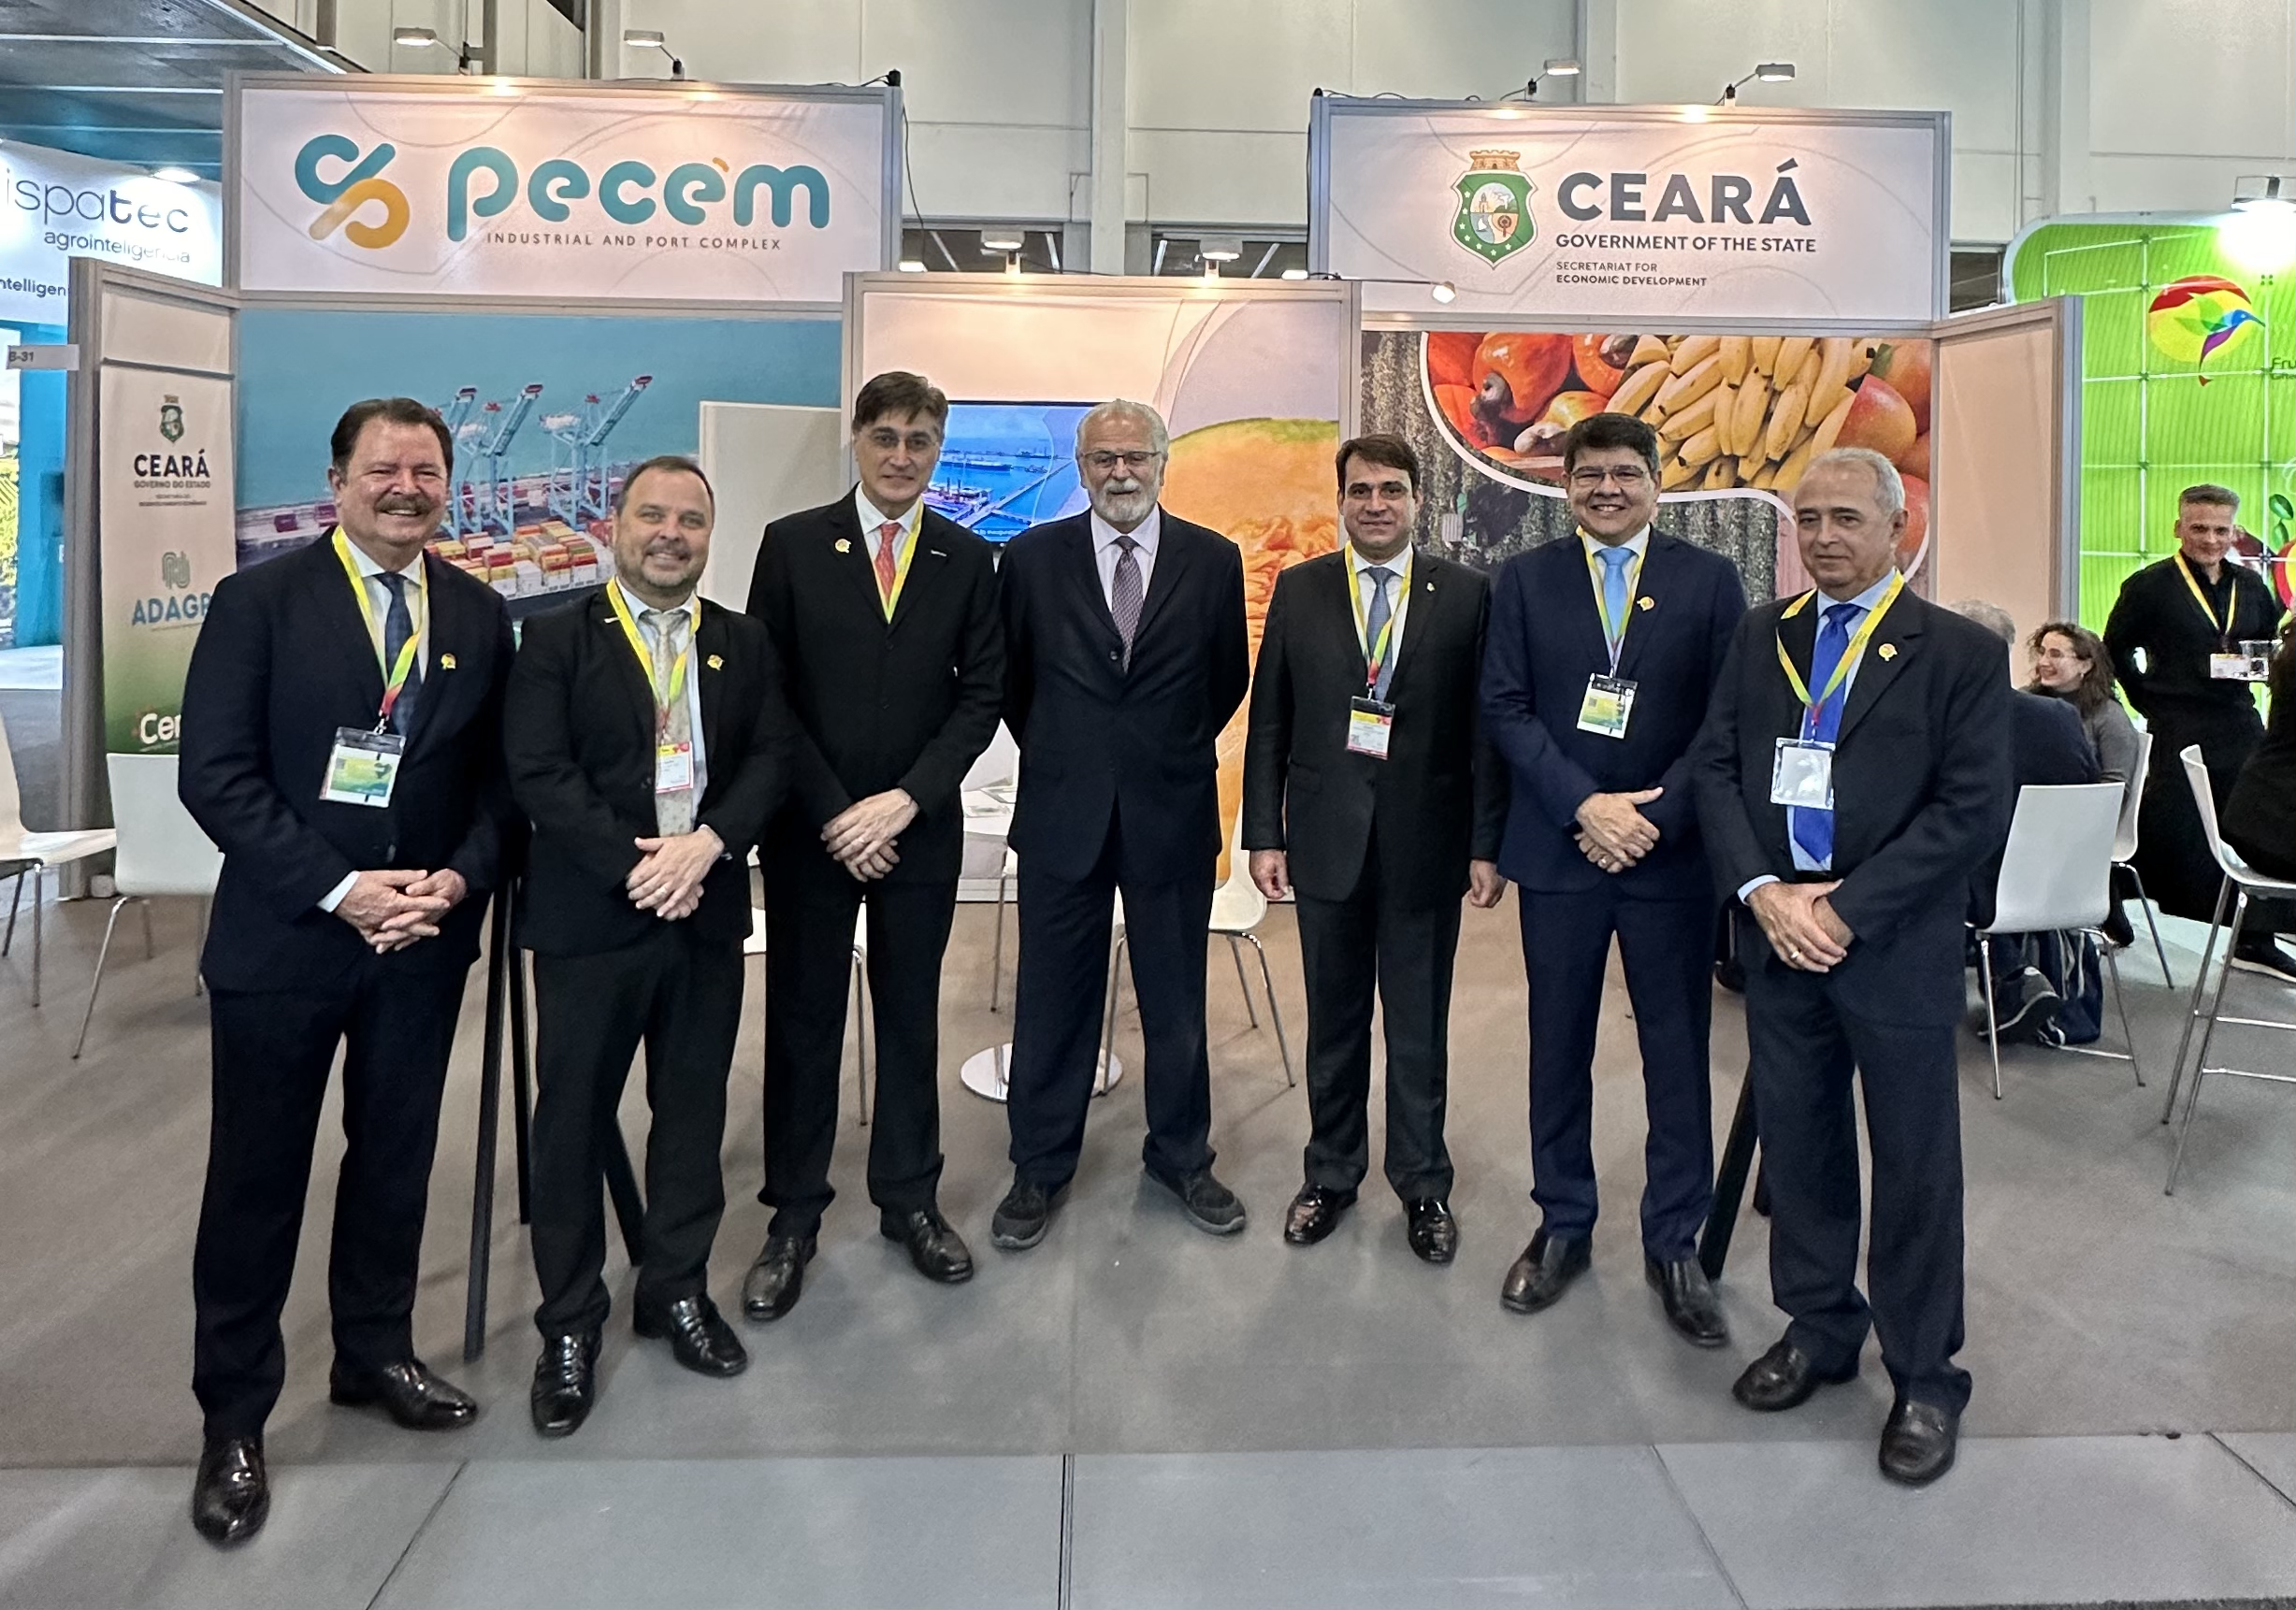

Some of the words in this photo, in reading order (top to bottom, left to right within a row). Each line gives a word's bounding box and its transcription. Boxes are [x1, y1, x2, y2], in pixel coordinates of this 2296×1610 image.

[6, 167, 189, 233] ispatec
[1557, 157, 1812, 226] CEARÁ
[486, 233, 593, 246] INDUSTRIAL
[602, 235, 636, 247] AND
[646, 236, 689, 249] PORT
[700, 237, 781, 251] COMPLEX
[1555, 234, 1688, 251] GOVERNMENT
[1692, 236, 1718, 252] OF
[1721, 237, 1757, 252] THE
[1761, 237, 1816, 252] STATE
[1556, 261, 1632, 272] SECRETARIAT
[1636, 262, 1657, 273] FOR
[1556, 274, 1619, 285] ECONOMIC
[1623, 276, 1707, 287] DEVELOPMENT
[134, 448, 210, 478] CEARÁ
